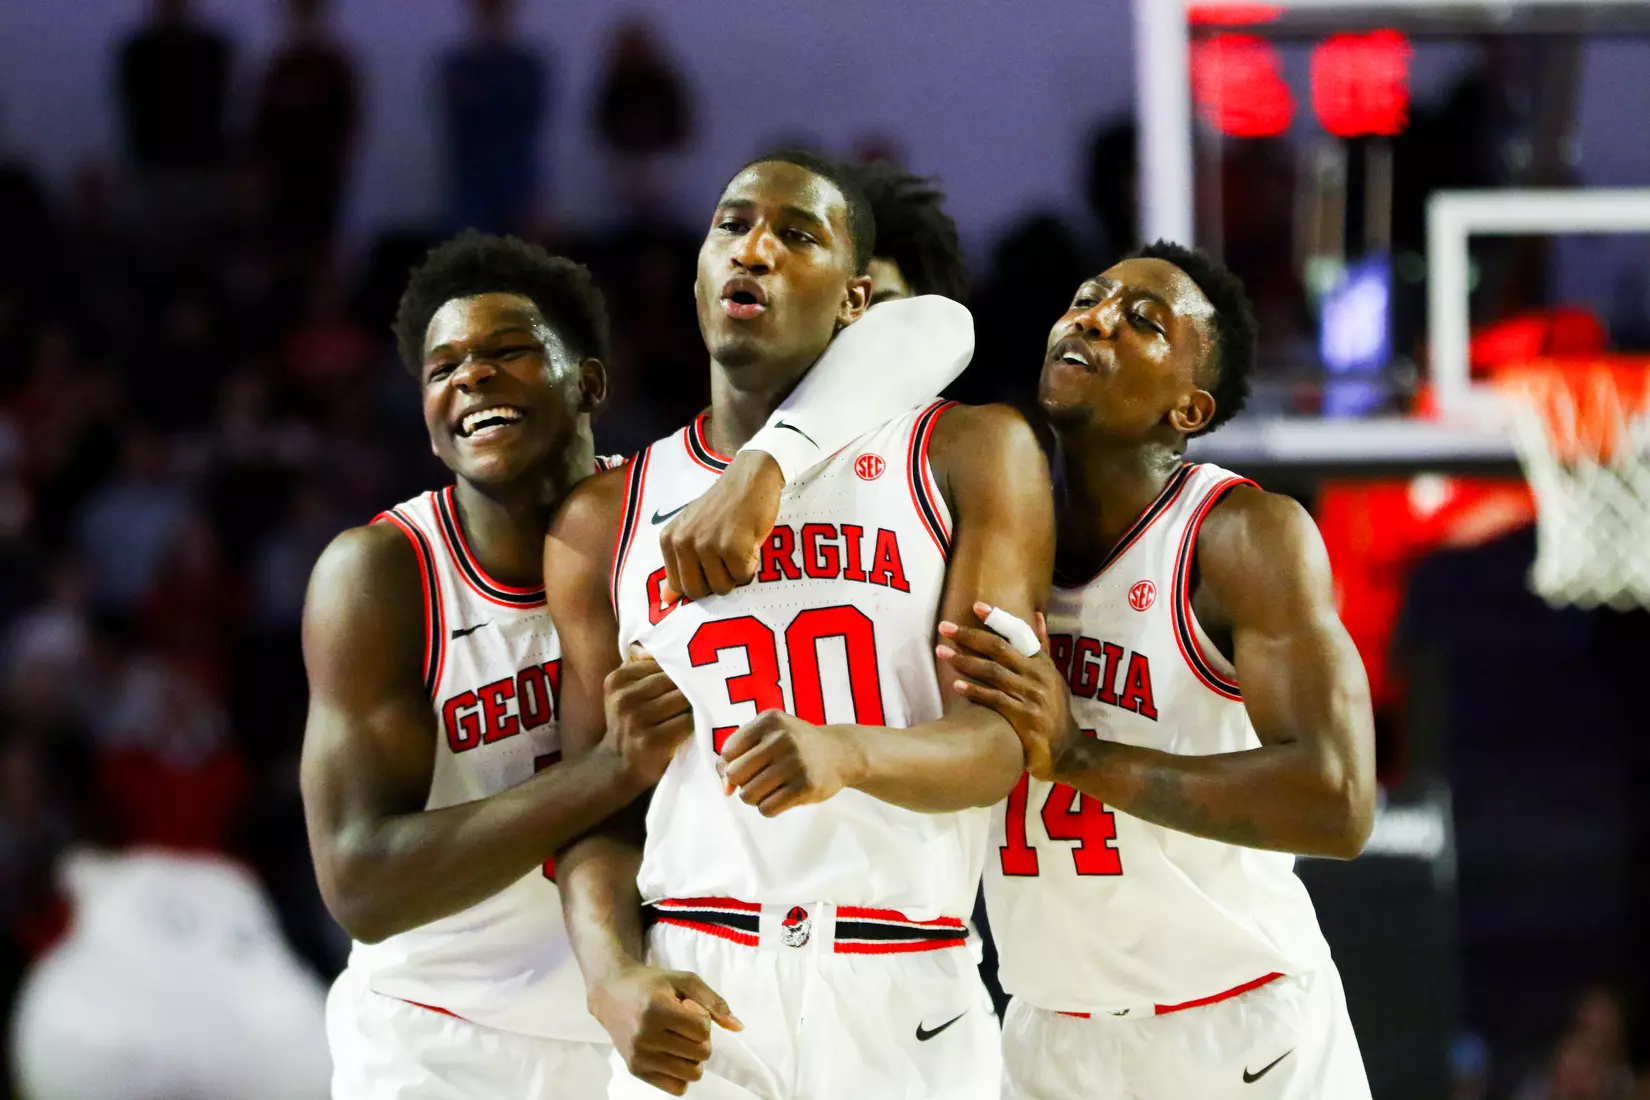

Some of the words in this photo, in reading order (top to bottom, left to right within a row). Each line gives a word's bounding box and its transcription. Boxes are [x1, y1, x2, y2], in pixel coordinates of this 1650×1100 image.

[857, 455, 882, 478] SEC
[1131, 583, 1154, 608] SEC
[442, 658, 563, 754] GEO
[688, 604, 887, 756] 30
[999, 729, 1123, 876] 14
